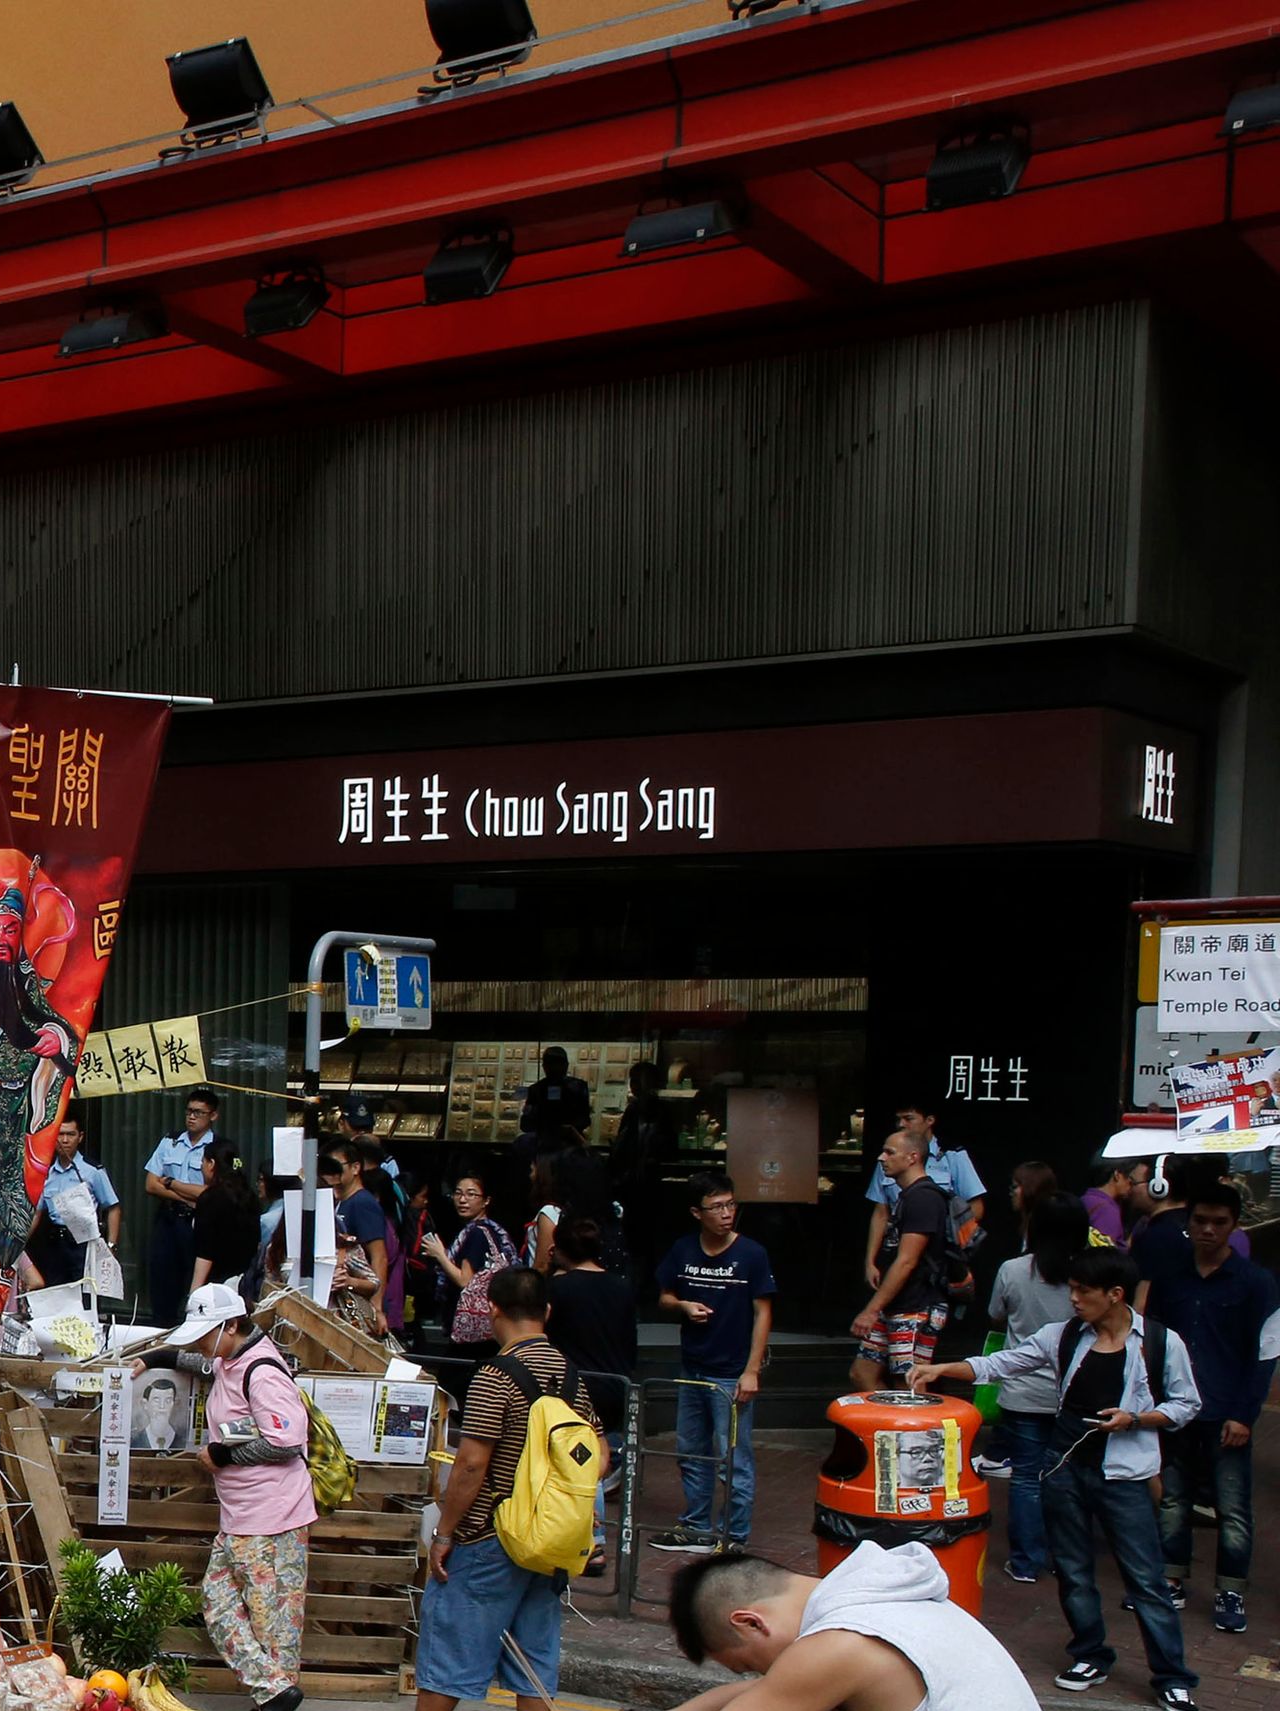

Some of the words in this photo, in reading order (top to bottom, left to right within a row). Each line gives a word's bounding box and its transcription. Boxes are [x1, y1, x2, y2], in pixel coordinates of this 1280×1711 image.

[338, 773, 450, 843] 周生生
[465, 788, 544, 837] Chow
[556, 781, 628, 842] Sang
[639, 777, 715, 839] Sang
[1173, 934, 1277, 955] 關帝廟道
[1163, 968, 1213, 982] Kwan
[1219, 967, 1247, 981] Tei
[1162, 998, 1228, 1015] Temple
[945, 1055, 1030, 1102] 周生生
